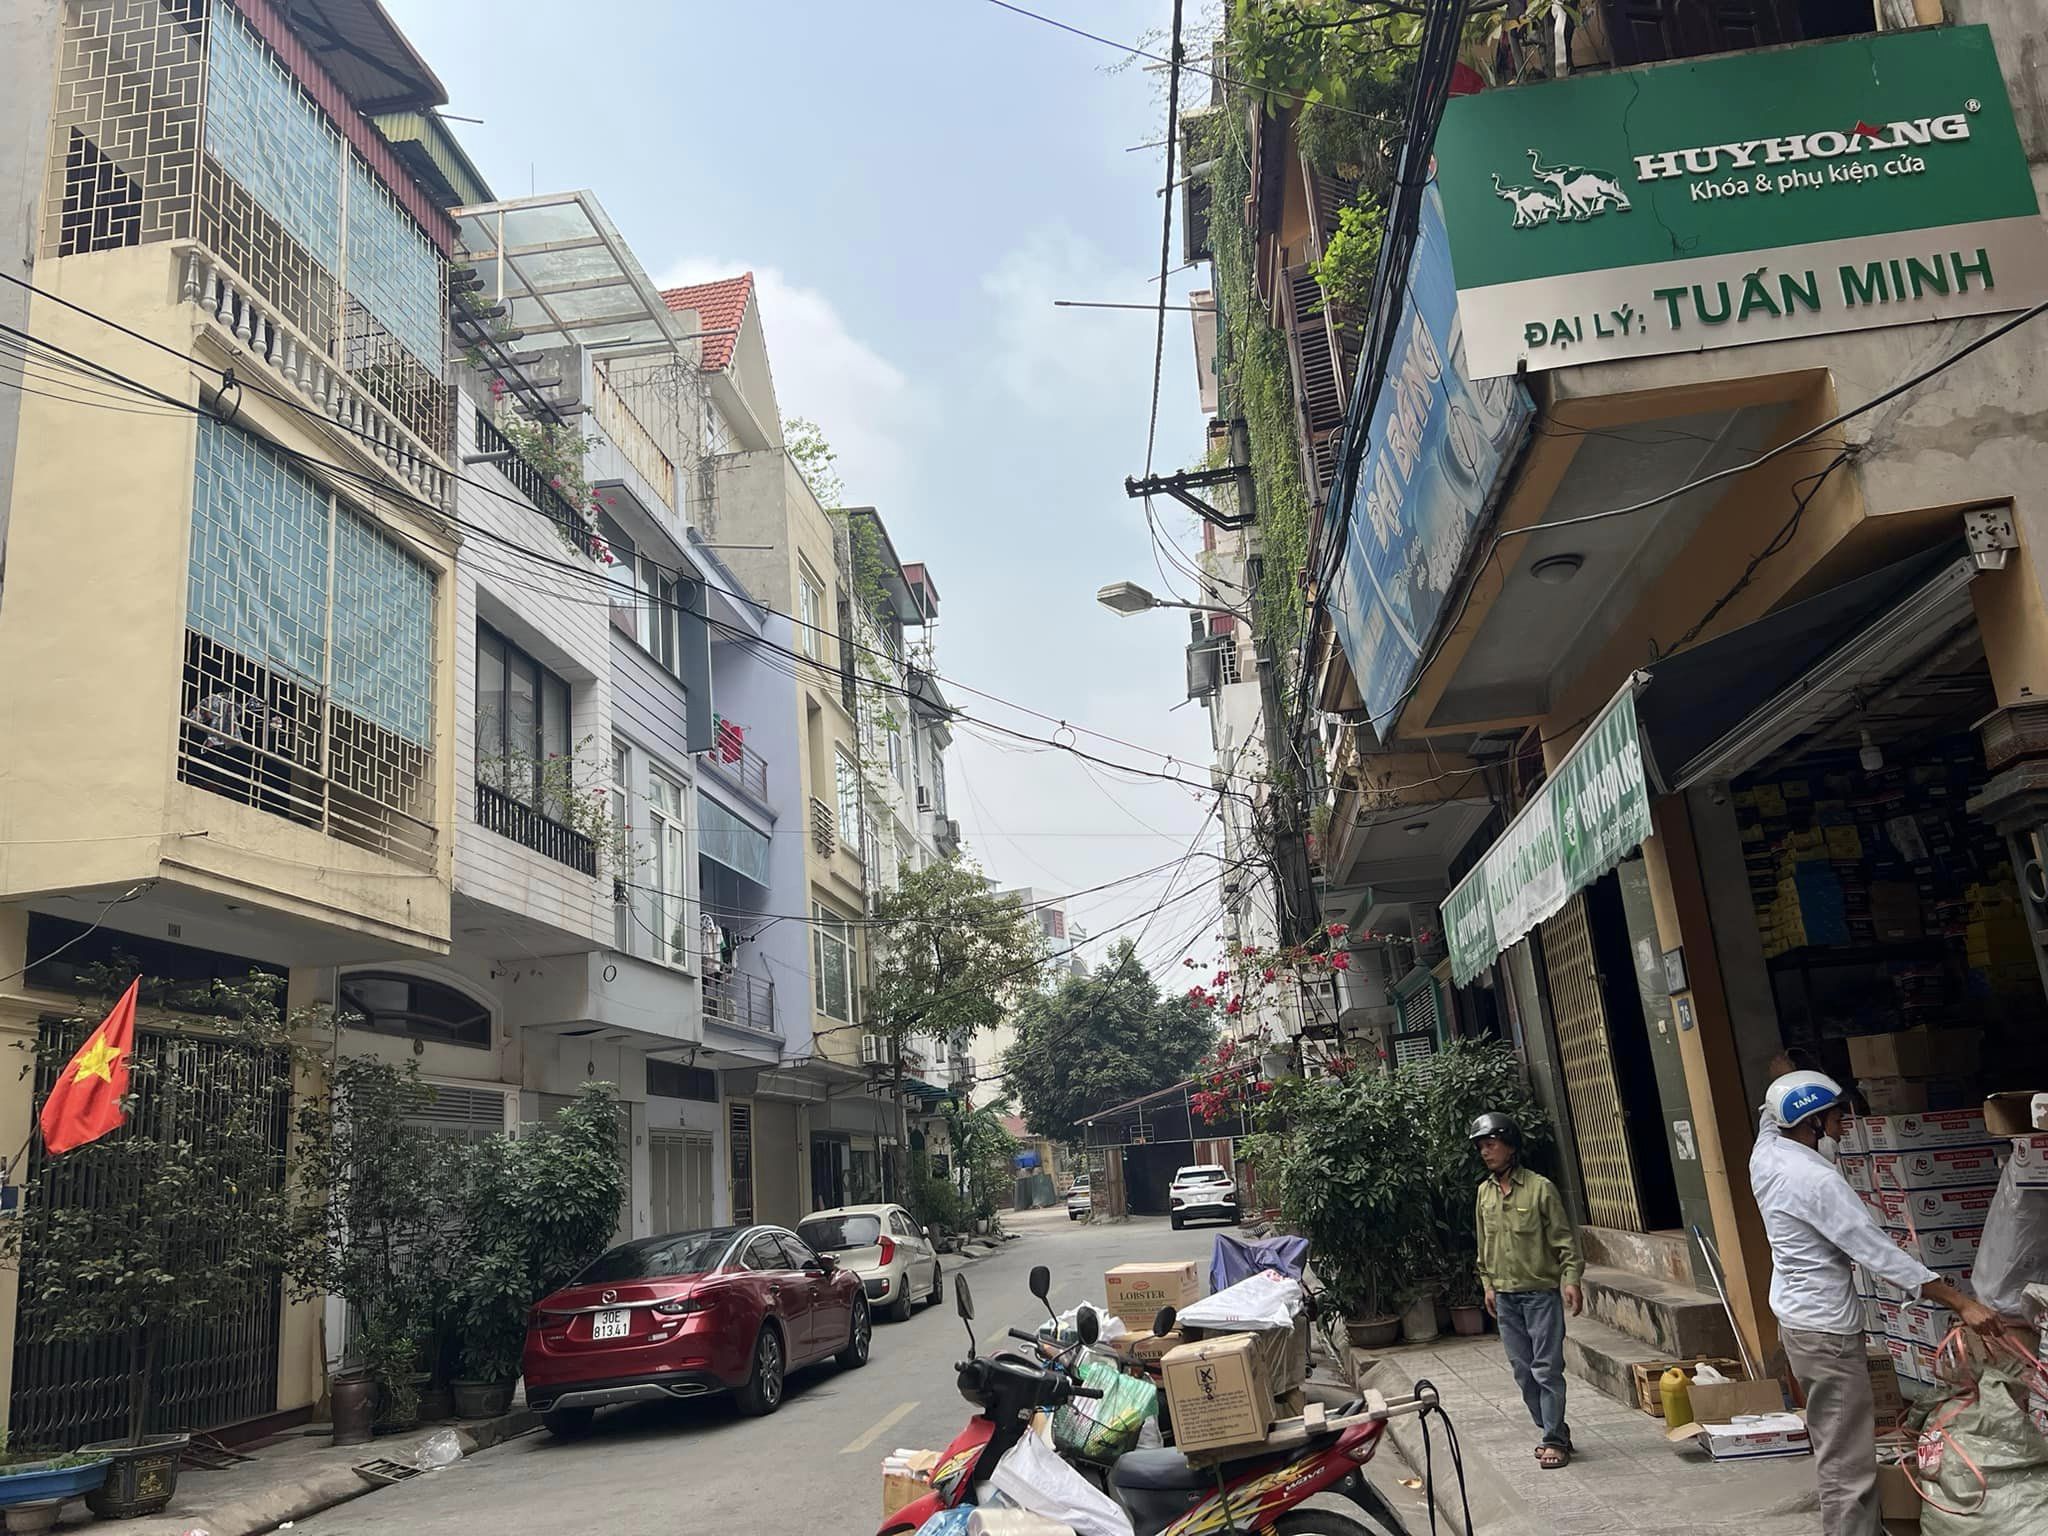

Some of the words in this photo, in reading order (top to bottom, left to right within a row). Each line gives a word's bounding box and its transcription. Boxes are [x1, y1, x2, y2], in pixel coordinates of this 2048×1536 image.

[1690, 174, 1750, 203] Khóa
[1754, 173, 1774, 193] &
[1778, 165, 1824, 196] phụ
[1828, 159, 1879, 186] kiện
[1883, 155, 1927, 180] cửa
[1524, 314, 1583, 350] ĐẠI
[1653, 266, 1822, 331] TUẤN
[1838, 248, 1996, 307] MINH
[1679, 1004, 1691, 1024] 76
[1120, 1289, 1166, 1301] LOBSTER
[602, 1311, 622, 1324] 30E
